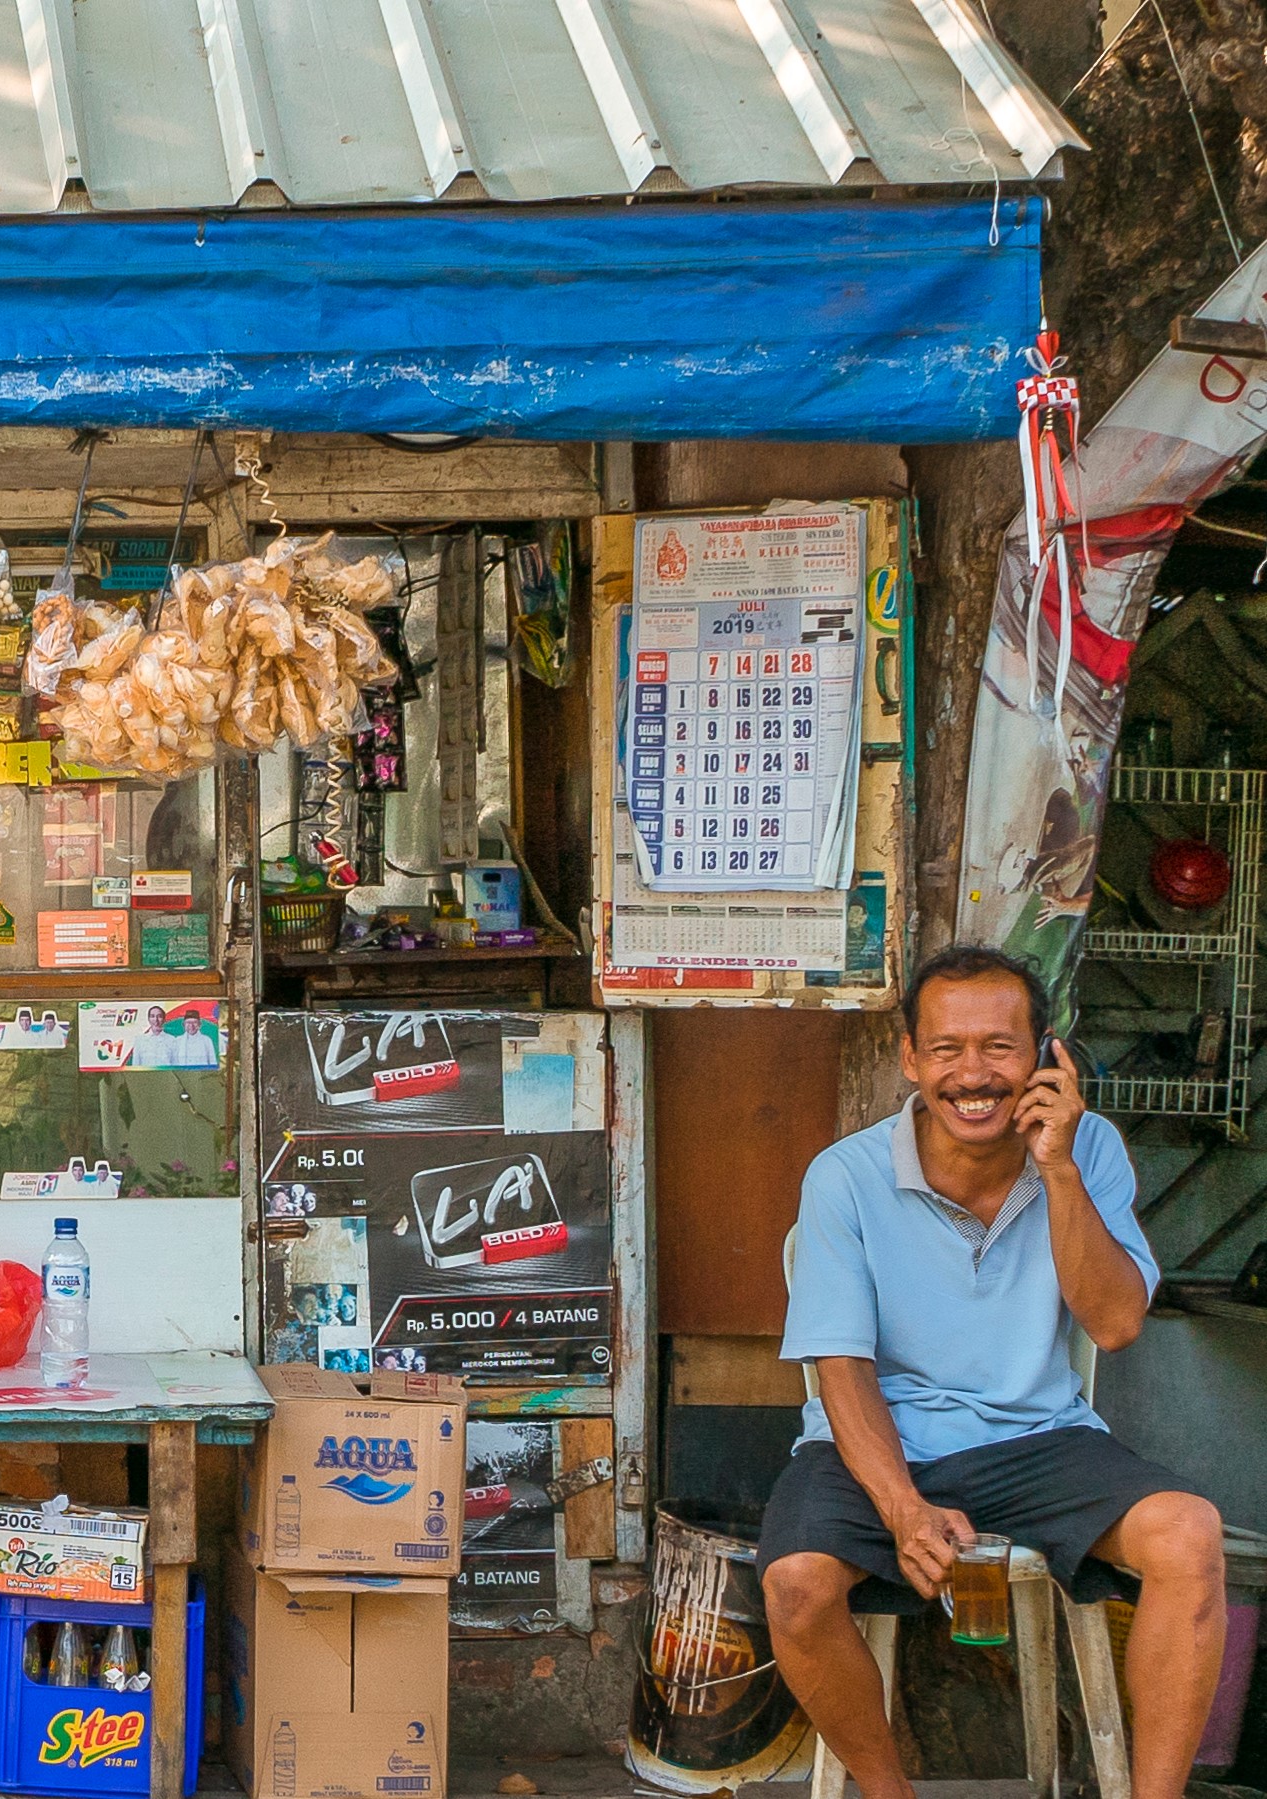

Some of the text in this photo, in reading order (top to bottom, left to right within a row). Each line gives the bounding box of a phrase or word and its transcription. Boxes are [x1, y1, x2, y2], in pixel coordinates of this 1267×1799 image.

[728, 612, 747, 620] JULY
[737, 602, 766, 613] JULI
[713, 619, 755, 634] 2019
[709, 652, 812, 676] 7 14 21 28
[679, 689, 685, 708] 1
[708, 688, 718, 708] 8
[736, 688, 752, 708] 15
[762, 687, 782, 707] 22
[792, 686, 813, 706] 29
[638, 719, 812, 740] SELASA 2 9 16 23 30
[676, 753, 685, 772] 3
[703, 753, 720, 773] 10
[735, 753, 751, 773] 17
[762, 752, 782, 772] 24
[794, 751, 810, 771] 31
[675, 786, 685, 806] 4
[704, 786, 717, 806] 11
[733, 785, 750, 805] 18
[761, 785, 781, 805] 25
[674, 817, 780, 838] 5 12 19 26
[673, 850, 683, 870] 6
[701, 850, 717, 870] 13
[729, 850, 749, 870] 20
[758, 850, 779, 870] 27
[473, 903, 510, 912] TOKAI
[656, 955, 798, 968] KALENDER 2018
[121, 1011, 137, 1025] 01
[324, 1011, 426, 1081] LA
[378, 1064, 437, 1085] BOLD
[298, 1155, 320, 1171] Rp.
[38, 1177, 58, 1194] 01
[432, 1162, 533, 1245] LA
[486, 1227, 545, 1247] BOLD
[51, 1275, 81, 1287] AQUA
[406, 1308, 599, 1332] Rp. 5.000 / 4 BATANG
[462, 1360, 499, 1368] MEROKOK
[364, 1411, 380, 1419] 600
[381, 1411, 391, 1419] ml
[314, 1435, 418, 1477] AQUA
[15, 1549, 59, 1579] Rio
[114, 1572, 133, 1586] 15
[457, 1570, 541, 1586] 4 BATANG
[39, 1708, 145, 1765] S-tee
[104, 1757, 138, 1767] 318 ml
